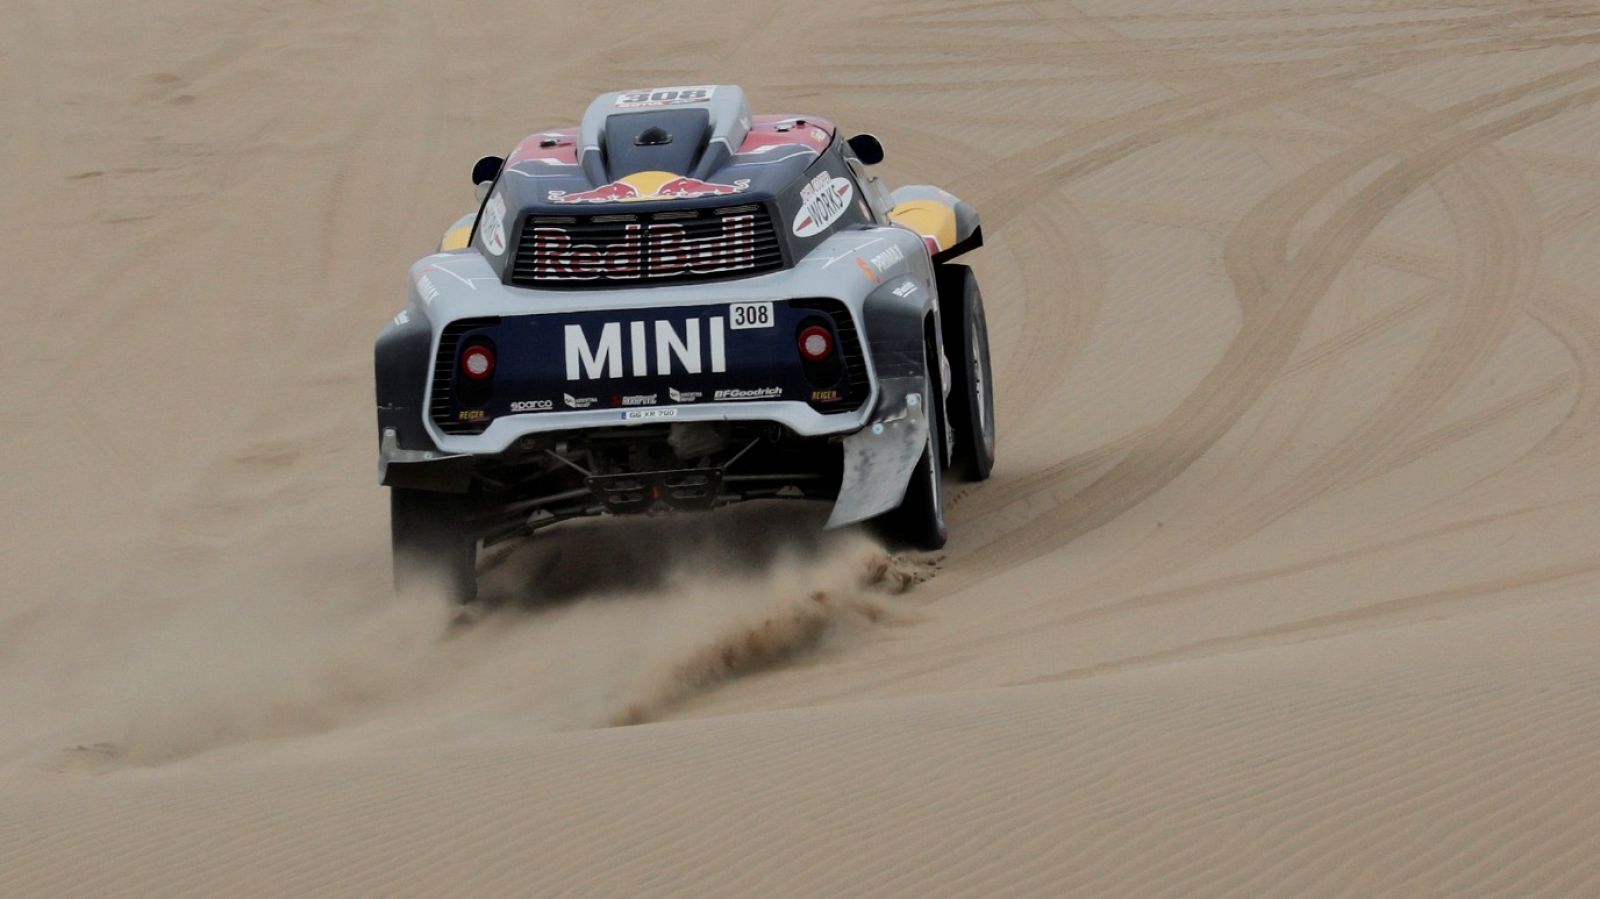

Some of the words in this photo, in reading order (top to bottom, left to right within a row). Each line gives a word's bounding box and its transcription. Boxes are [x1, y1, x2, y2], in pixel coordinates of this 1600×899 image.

[622, 89, 708, 103] 308
[807, 184, 844, 228] WORKS
[534, 224, 641, 280] Red
[648, 214, 755, 278] Bull
[735, 305, 769, 326] 308
[564, 316, 727, 381] MINI
[714, 386, 784, 400] BFGoodrich
[510, 399, 553, 411] sparco
